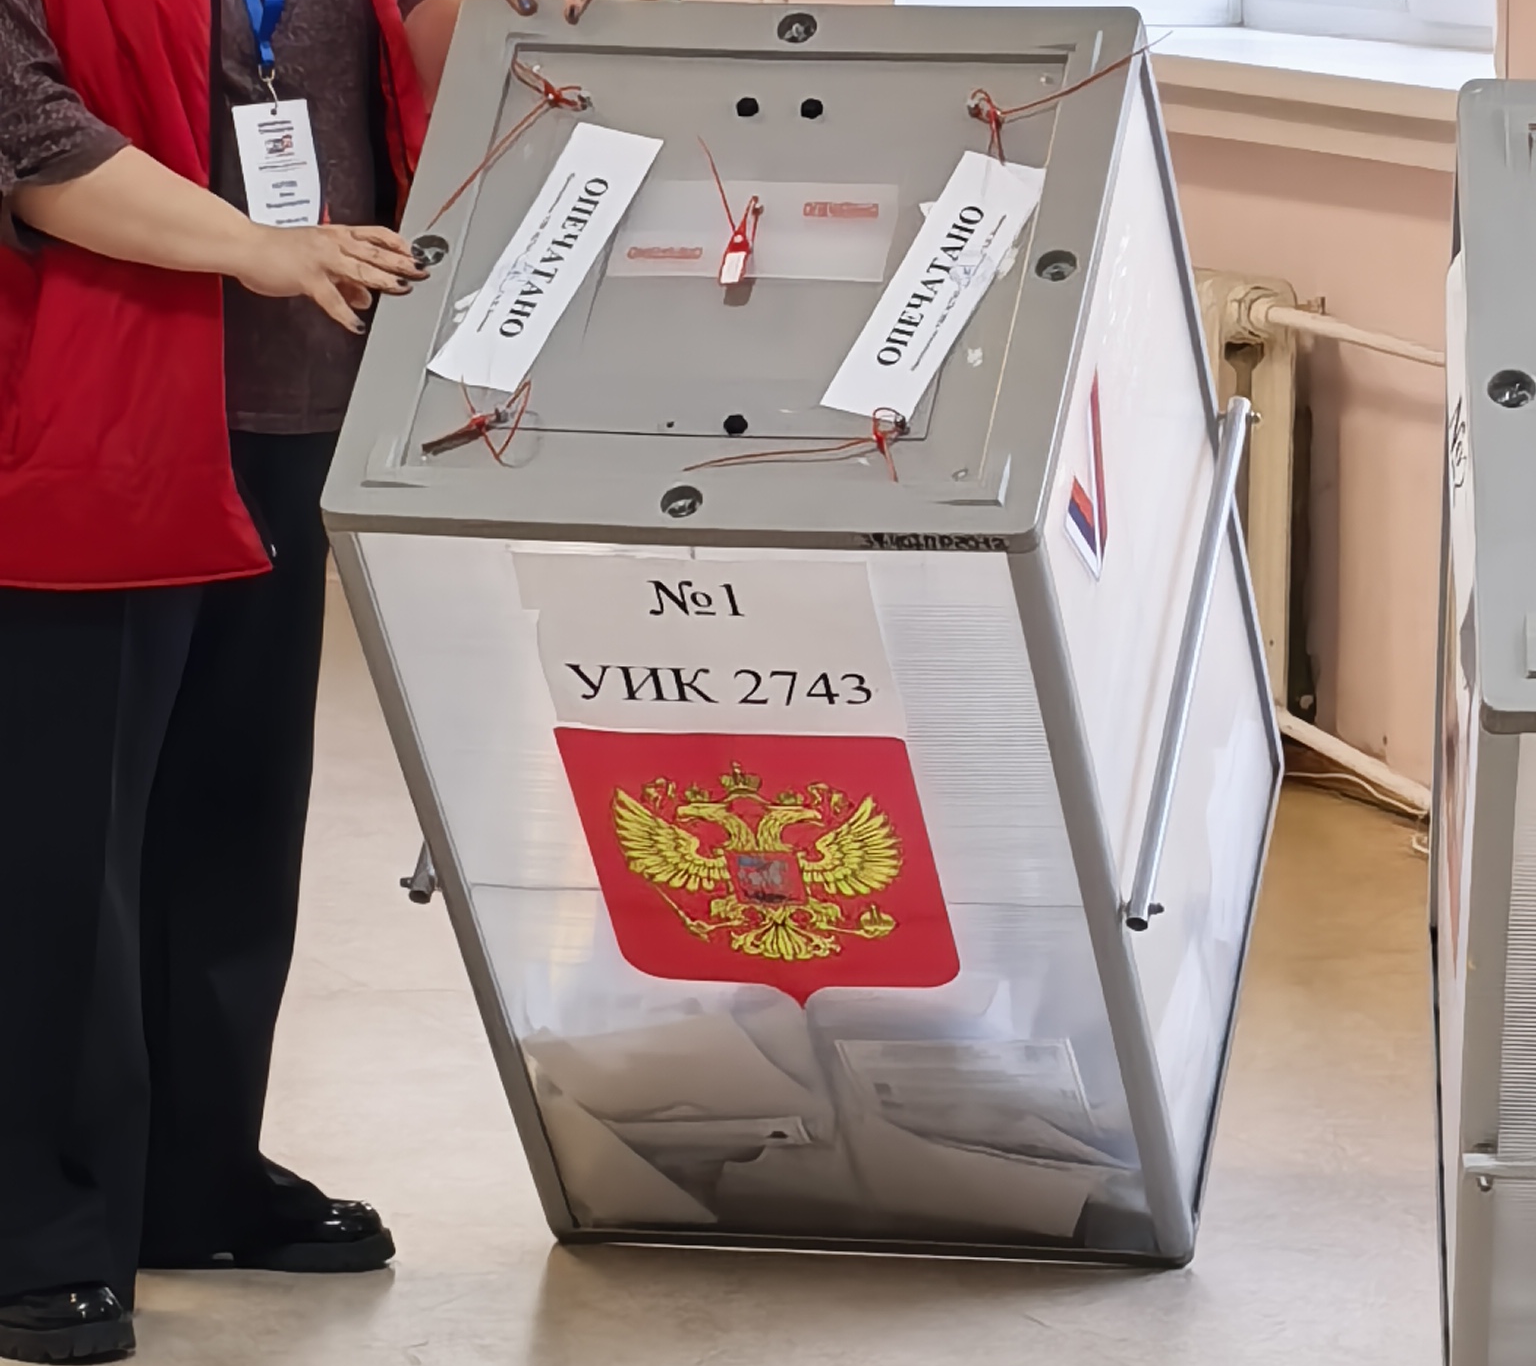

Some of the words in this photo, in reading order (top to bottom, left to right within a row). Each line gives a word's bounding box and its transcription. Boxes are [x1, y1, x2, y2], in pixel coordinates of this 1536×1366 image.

[499, 177, 609, 338] ОПЕЧАТАНО
[876, 205, 985, 366] ОПЕЧАТАНО
[647, 580, 745, 617] №1
[564, 662, 719, 704] УИК
[733, 669, 873, 706] 2743
